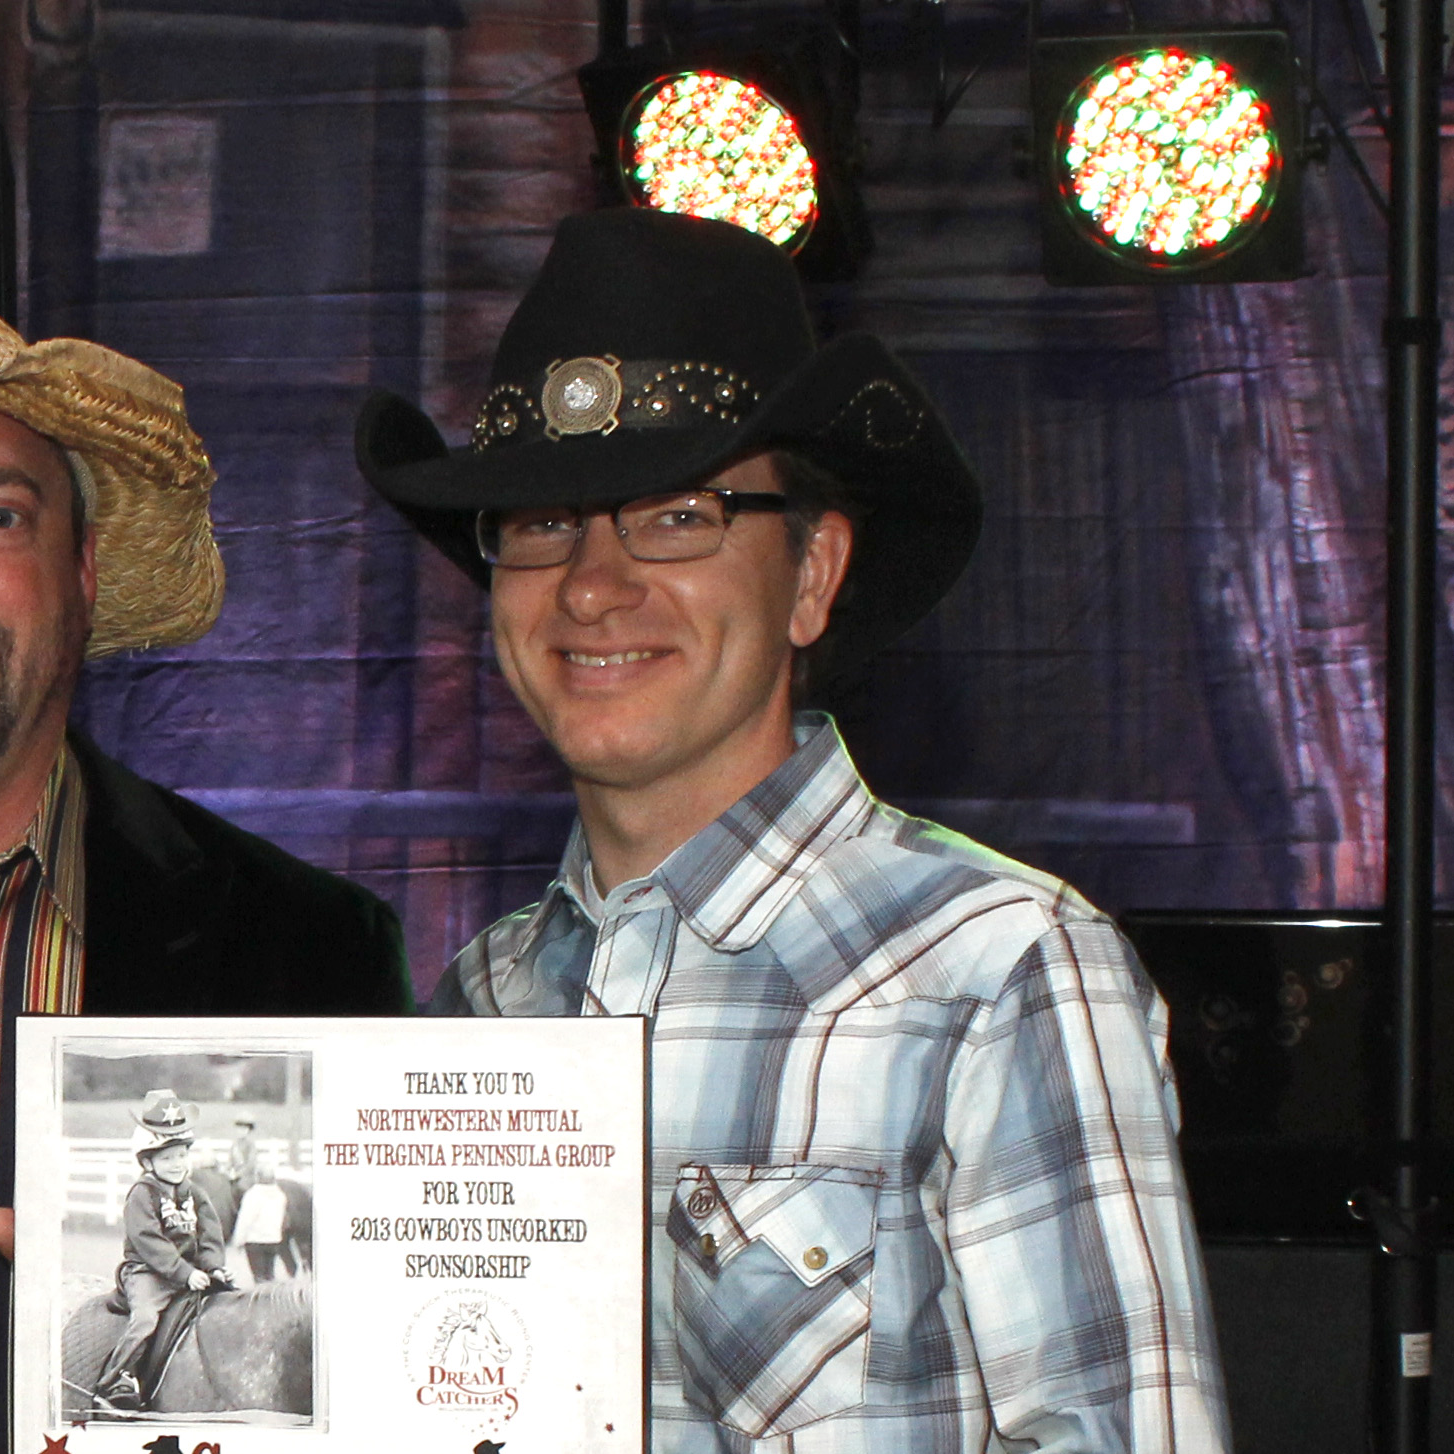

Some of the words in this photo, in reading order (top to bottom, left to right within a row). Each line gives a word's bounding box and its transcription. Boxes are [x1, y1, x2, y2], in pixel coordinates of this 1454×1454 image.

[404, 1072, 468, 1095] THANK
[472, 1072, 508, 1095] YOU
[512, 1072, 534, 1095] TO
[357, 1109, 501, 1131] NORTHWESTERN
[507, 1110, 582, 1132] MUTUAL
[324, 1144, 359, 1165] THE
[363, 1144, 447, 1166] VIRGINIA
[451, 1144, 552, 1167] PENINSULA
[556, 1145, 616, 1167] GROUP
[422, 1181, 459, 1205] FOR
[464, 1181, 515, 1205] YOUR
[351, 1217, 391, 1241] 2013
[394, 1217, 483, 1242] COWBOYS
[487, 1219, 588, 1242] UNCORKED
[406, 1254, 531, 1279] SPONSORSHIP
[428, 1365, 505, 1386] DREAM
[416, 1386, 519, 1417] CATCHERS
